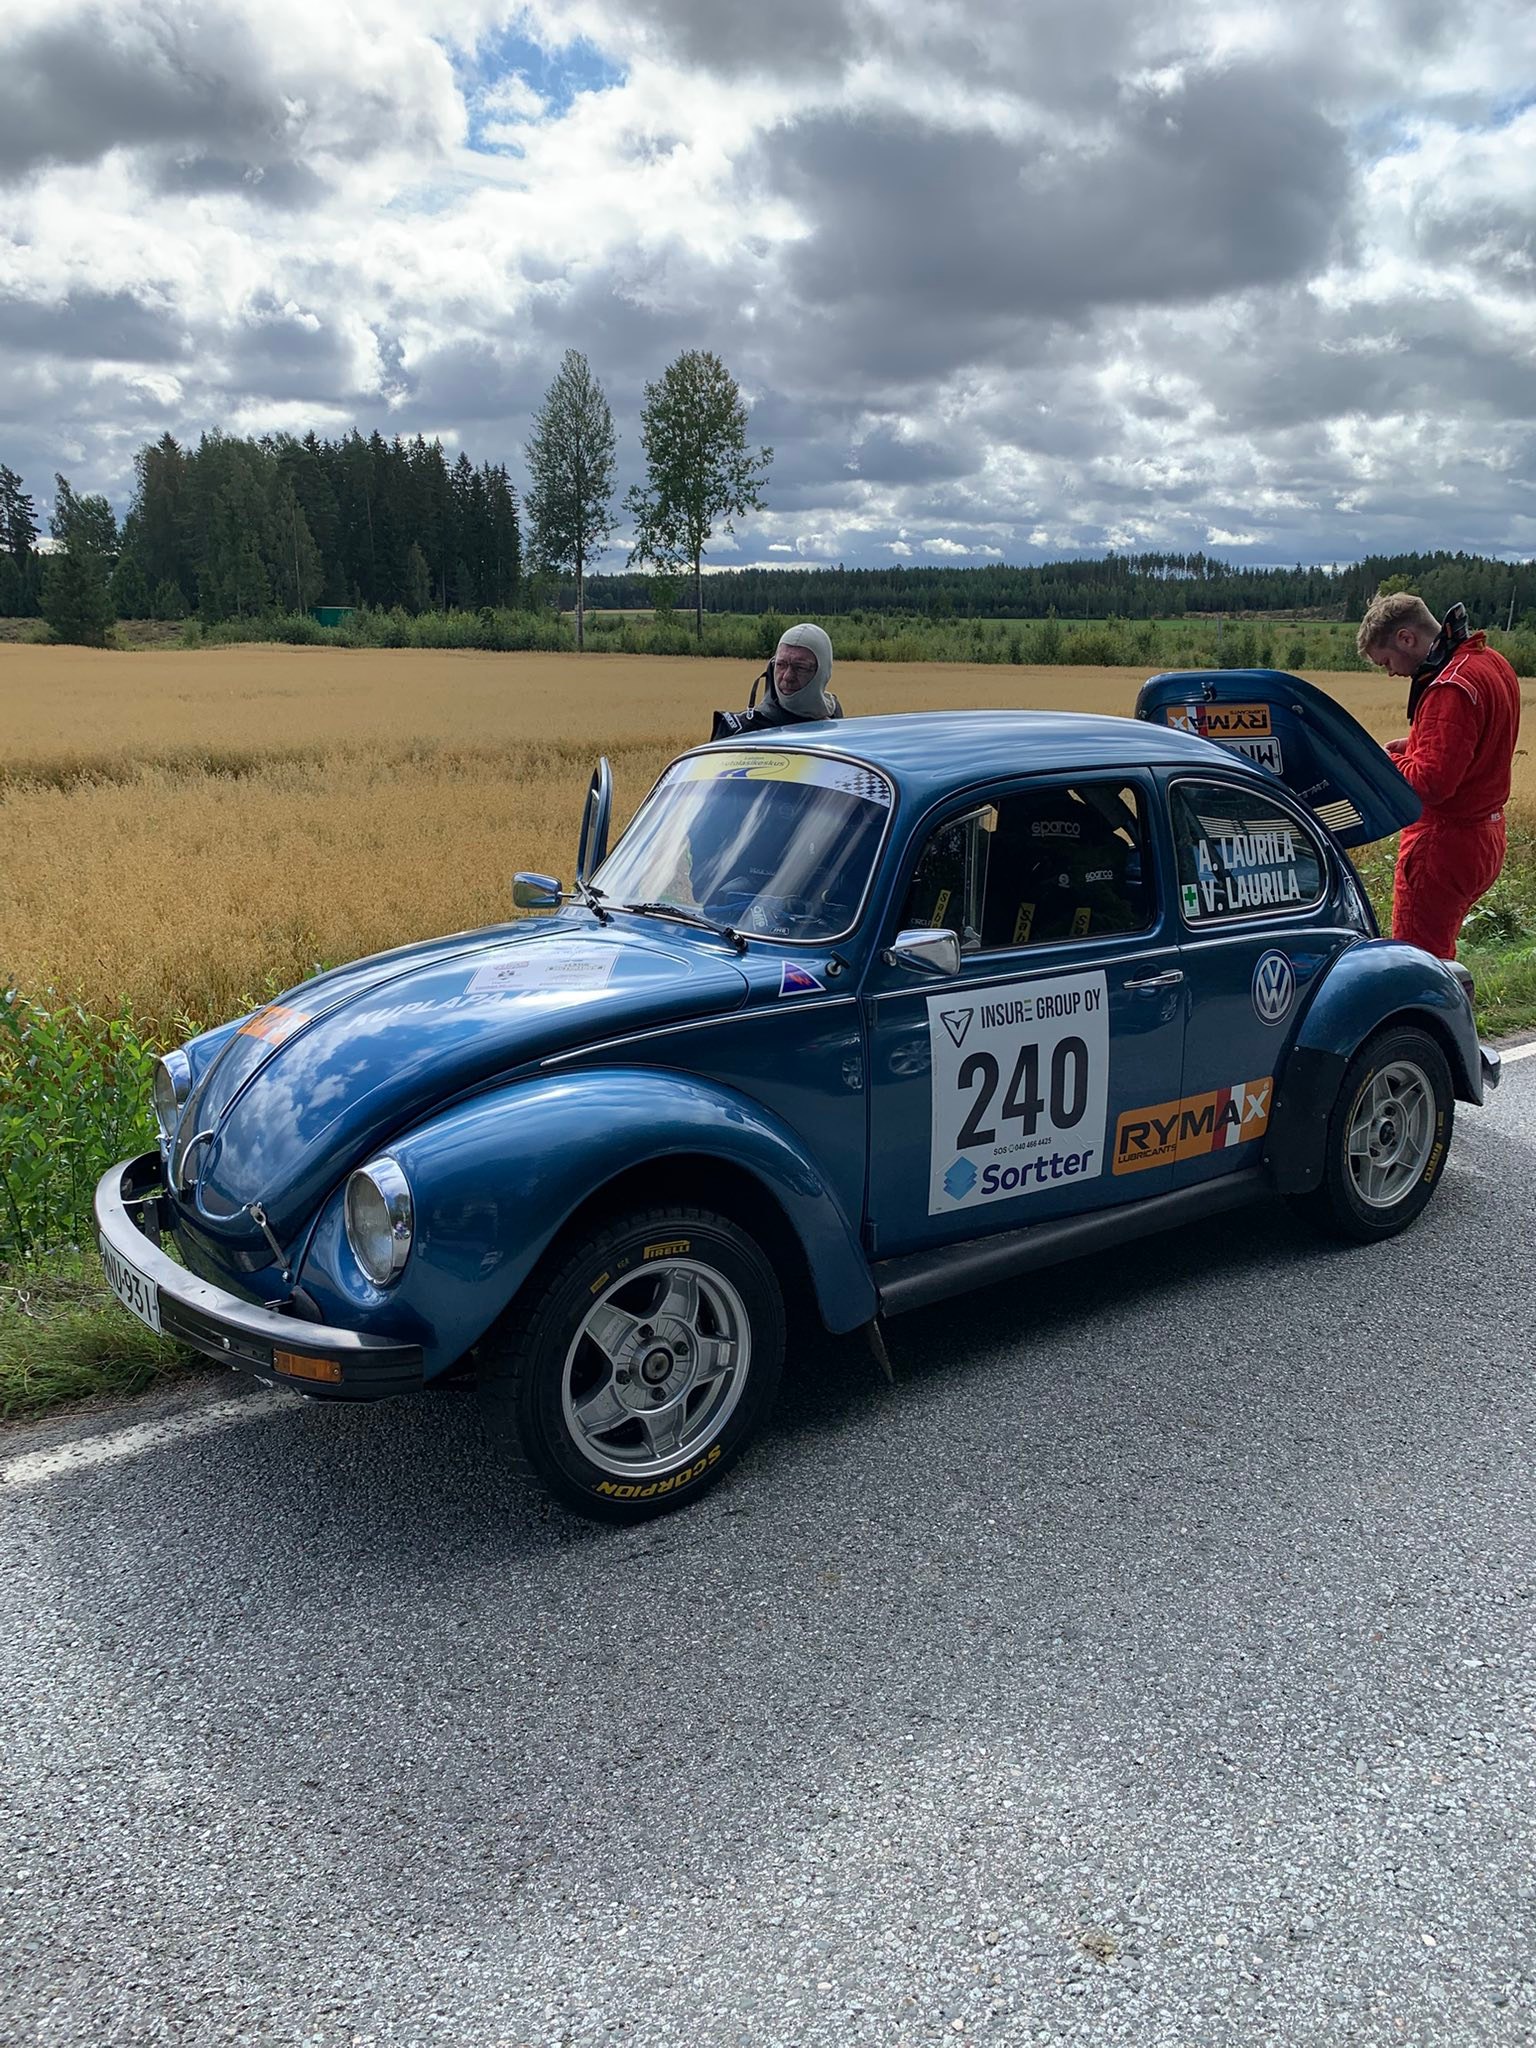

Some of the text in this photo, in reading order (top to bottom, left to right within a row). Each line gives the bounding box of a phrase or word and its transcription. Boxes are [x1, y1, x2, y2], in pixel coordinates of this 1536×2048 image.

[1169, 713, 1268, 731] RYMAX
[719, 759, 785, 767] utolasikeskus
[1031, 821, 1081, 838] sparco
[1198, 831, 1297, 873] A. LAURILA
[1200, 868, 1301, 913] V. LAURILA
[981, 987, 1101, 1029] INSURE GROUP OY
[957, 1036, 1089, 1151] 240
[1119, 1089, 1270, 1155] RYMAX
[981, 1149, 1094, 1195] Sortter
[993, 1146, 1008, 1156] SOS
[1118, 1144, 1177, 1164] LUBRICANTS
[643, 1240, 690, 1259] PIRELLI
[596, 1445, 721, 1498] SCORPION
